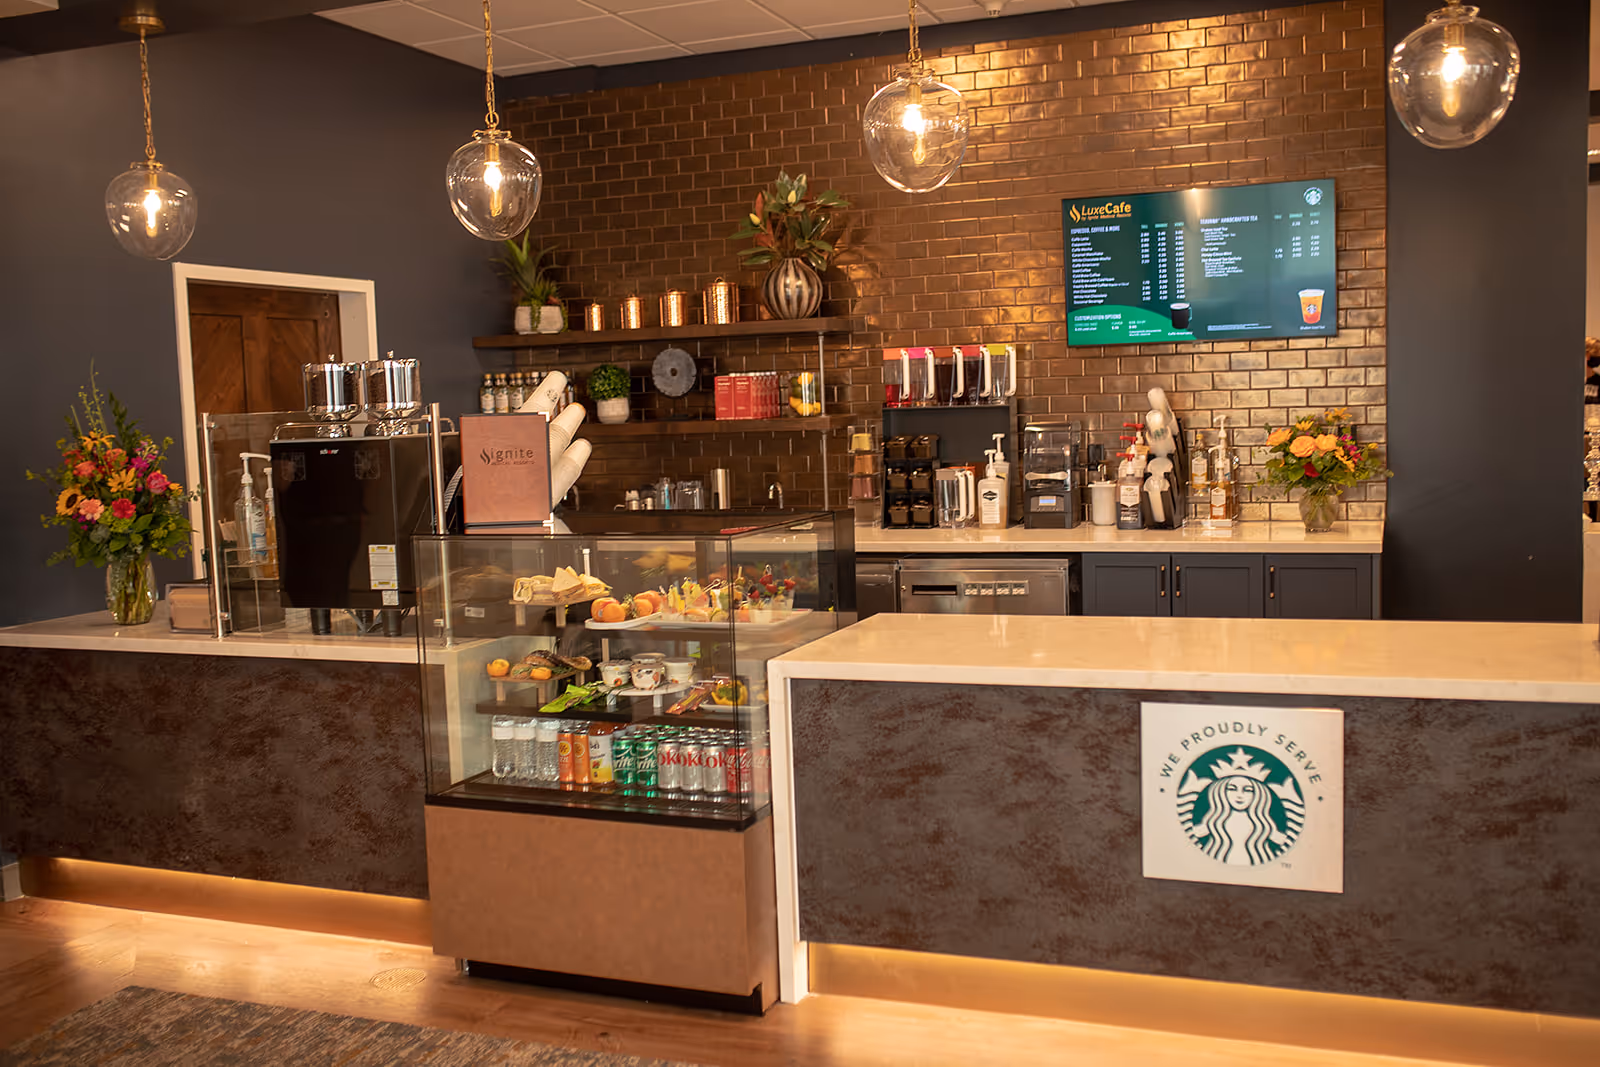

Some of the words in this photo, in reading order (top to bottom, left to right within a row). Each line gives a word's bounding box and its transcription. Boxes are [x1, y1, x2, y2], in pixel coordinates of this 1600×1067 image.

[1081, 201, 1132, 216] LuxeCafe
[490, 447, 535, 462] ignite
[1160, 753, 1181, 778] WE
[1180, 721, 1268, 751] PROUDLY
[1274, 733, 1322, 784] SERVE
